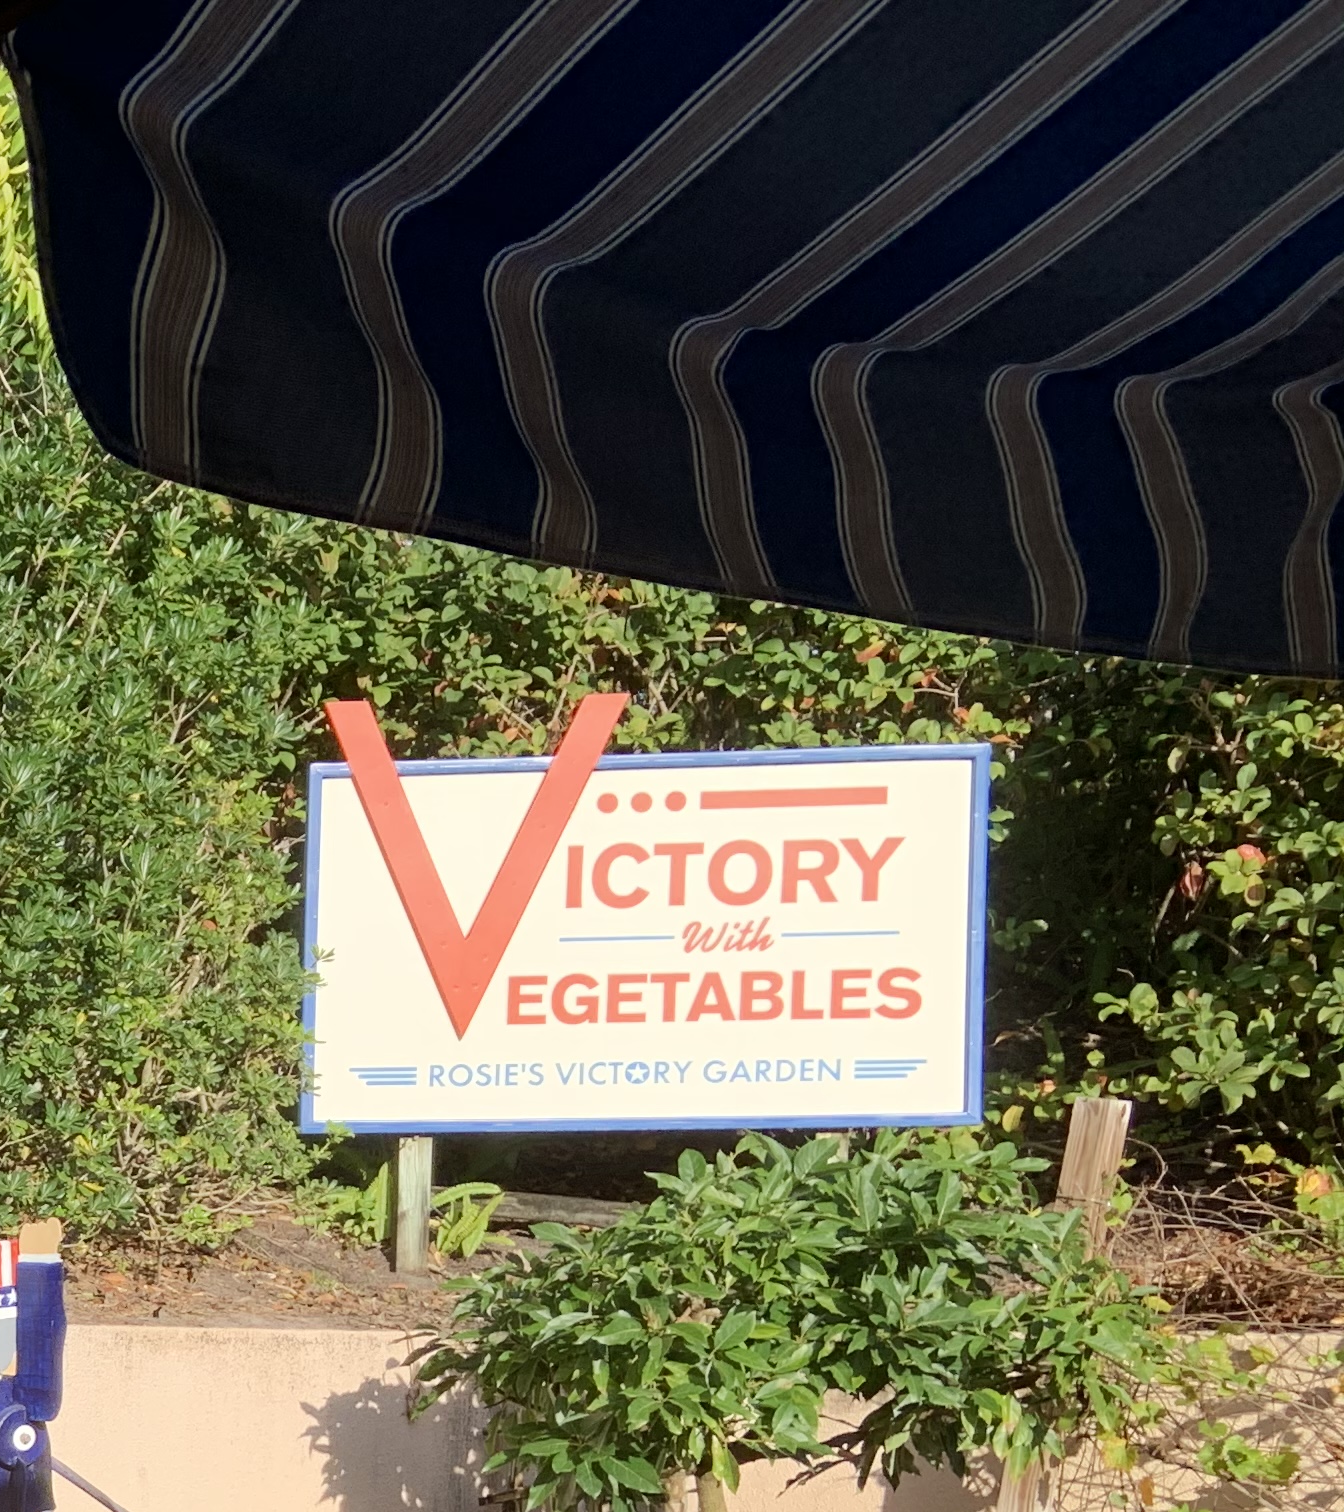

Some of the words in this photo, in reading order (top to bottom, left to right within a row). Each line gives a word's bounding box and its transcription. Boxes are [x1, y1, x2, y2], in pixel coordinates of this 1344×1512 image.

[682, 916, 774, 953] With
[429, 1063, 545, 1088] ROSIE'S
[555, 1060, 693, 1086] VICTORY
[703, 1058, 842, 1084] GARDEN
